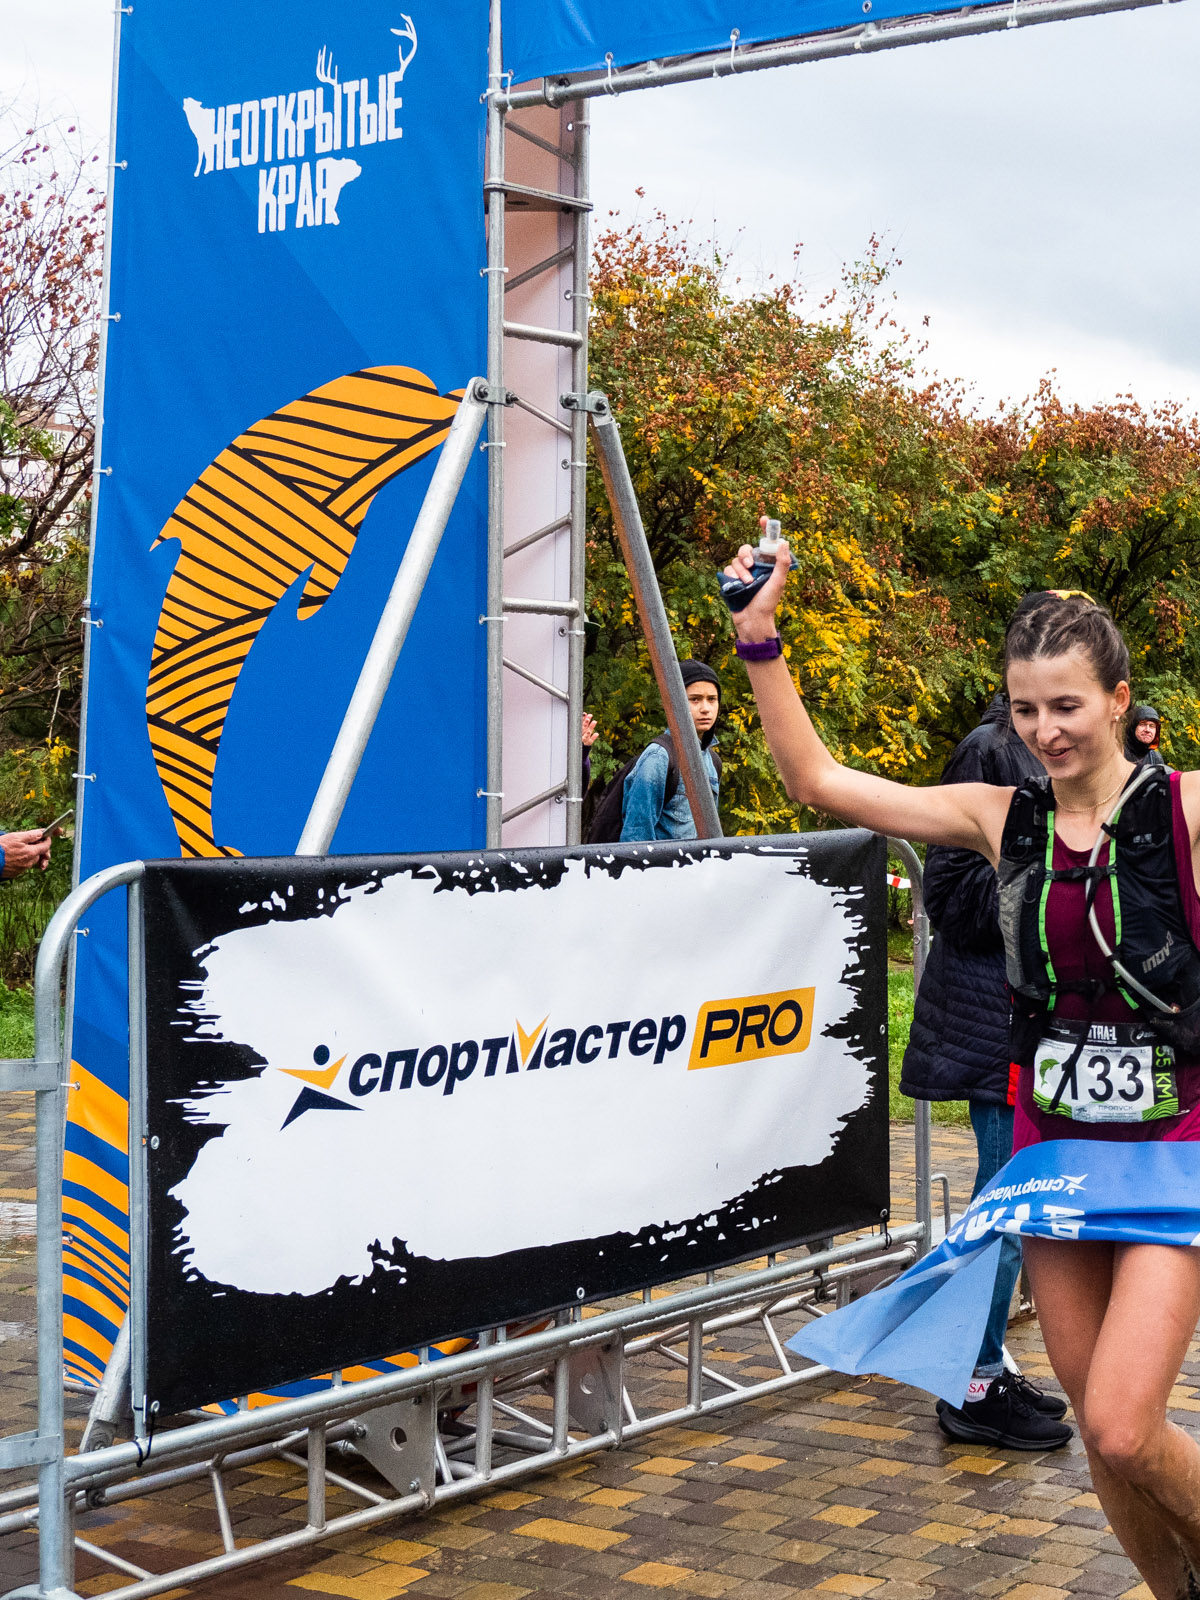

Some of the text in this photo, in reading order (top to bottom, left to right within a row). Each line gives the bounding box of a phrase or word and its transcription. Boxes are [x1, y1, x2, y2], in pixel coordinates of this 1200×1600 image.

[201, 71, 403, 172] НЕОТКРЫТЫЕ
[258, 157, 346, 234] КРАЯ
[698, 998, 802, 1058] PRO
